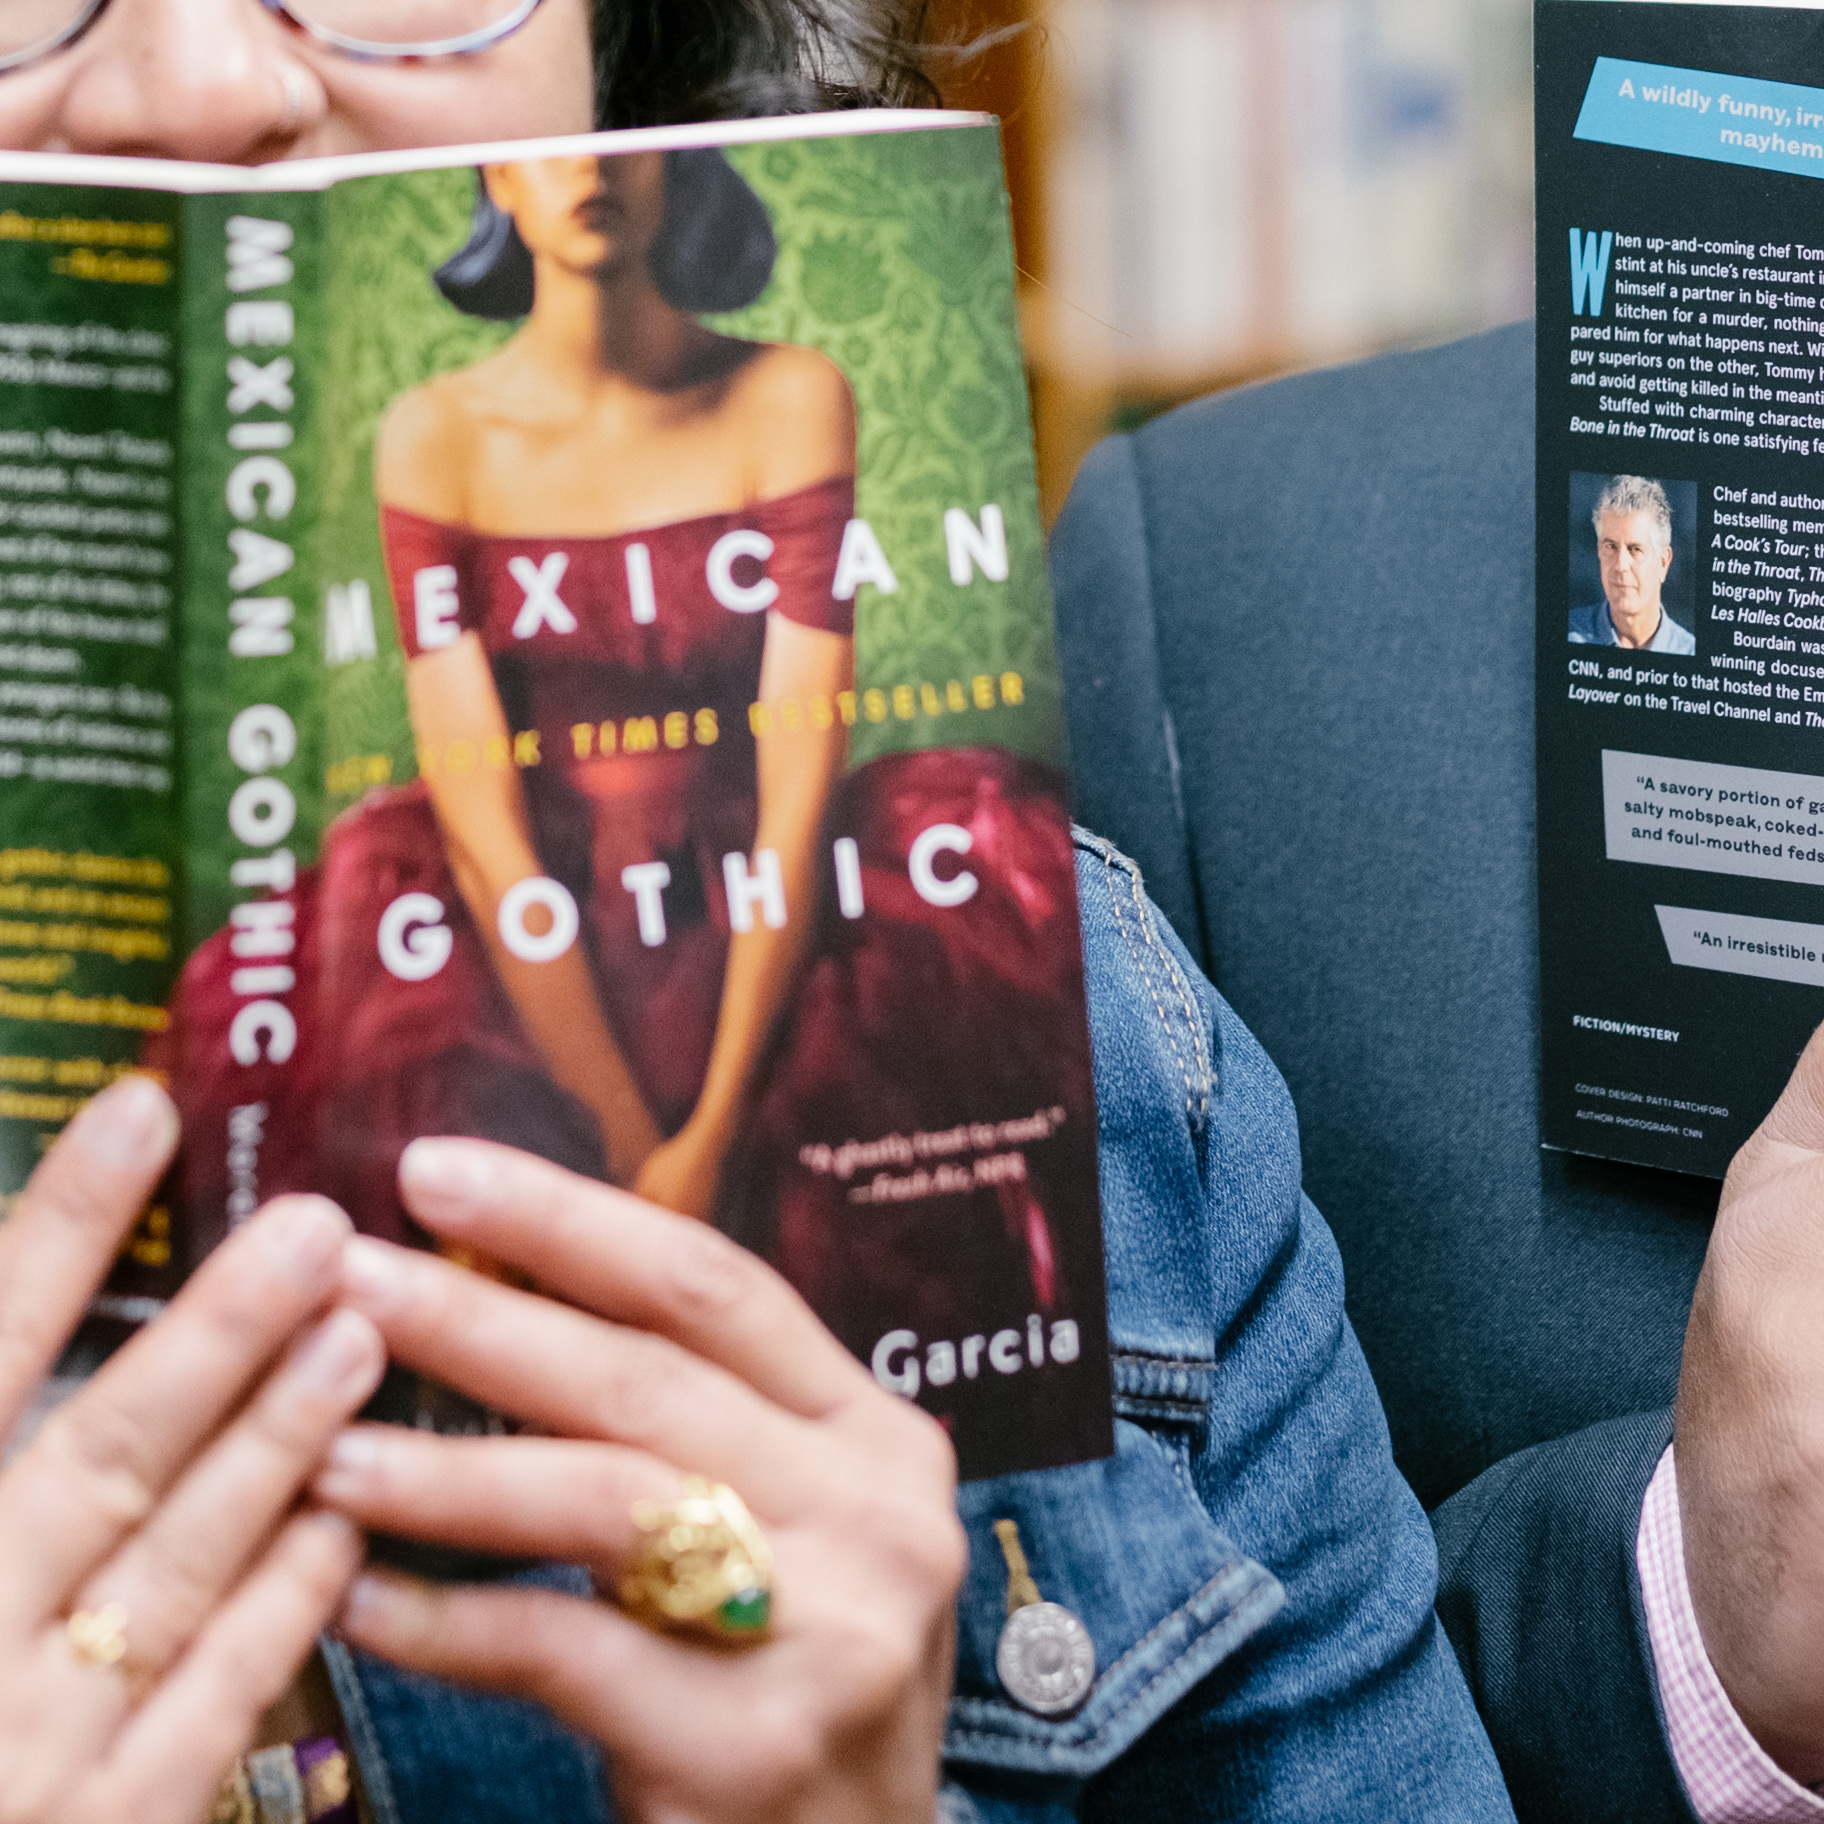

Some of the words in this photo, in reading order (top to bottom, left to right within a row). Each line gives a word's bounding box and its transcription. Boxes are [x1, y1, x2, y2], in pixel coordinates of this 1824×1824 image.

[1618, 77, 1636, 100] A
[1641, 83, 1712, 115] wildly
[1717, 92, 1792, 129] funny,
[1570, 370, 1596, 387] and
[1598, 372, 1636, 391] avoid
[1638, 376, 1688, 399] getting
[1690, 378, 1729, 398] killed
[1732, 381, 1745, 400] in
[1748, 383, 1773, 402] the
[226, 215, 295, 659] MEXICAN
[1569, 415, 1606, 435] Bone
[1607, 418, 1621, 436] in
[1622, 420, 1647, 439] the
[1649, 422, 1696, 443] Throat
[1698, 426, 1710, 445] is
[1712, 431, 1740, 447] one
[1743, 432, 1810, 457] satisfying
[325, 502, 1010, 667] MEXICAN
[570, 707, 720, 760] TIMES
[748, 670, 1025, 738] BESTSELLER
[1568, 682, 1621, 705] Layover
[1623, 692, 1642, 708] on
[1644, 692, 1668, 711] the
[1670, 695, 1711, 716] Travel
[1713, 700, 1771, 723] Channel
[1774, 709, 1801, 727] and
[1636, 775, 1656, 793] “A
[1659, 781, 1714, 802] savory
[1718, 788, 1781, 809] portion
[1785, 795, 1805, 811] of
[1624, 800, 1665, 821] salty
[1668, 806, 1762, 834] mobspeak,
[1631, 826, 1663, 842] and
[1666, 827, 1783, 858] foul-mouthed
[228, 706, 297, 1065] GOTHIC
[377, 821, 981, 983] GOTHIC
[1693, 929, 1723, 949] “An
[1727, 934, 1816, 963] irresistible
[1572, 1015, 1680, 1042] FICTION/MYSTERY
[1575, 1083, 1605, 1097] COVER
[1608, 1089, 1644, 1103] DESIGN:
[1646, 1095, 1671, 1107] PATTI
[1673, 1100, 1729, 1117] RATCHFORD
[1576, 1109, 1614, 1123] AUTHOR
[1616, 1116, 1680, 1135] PHOTOGRAPH:
[1683, 1127, 1703, 1139] CNN
[871, 1313, 1080, 1400] Garcia
